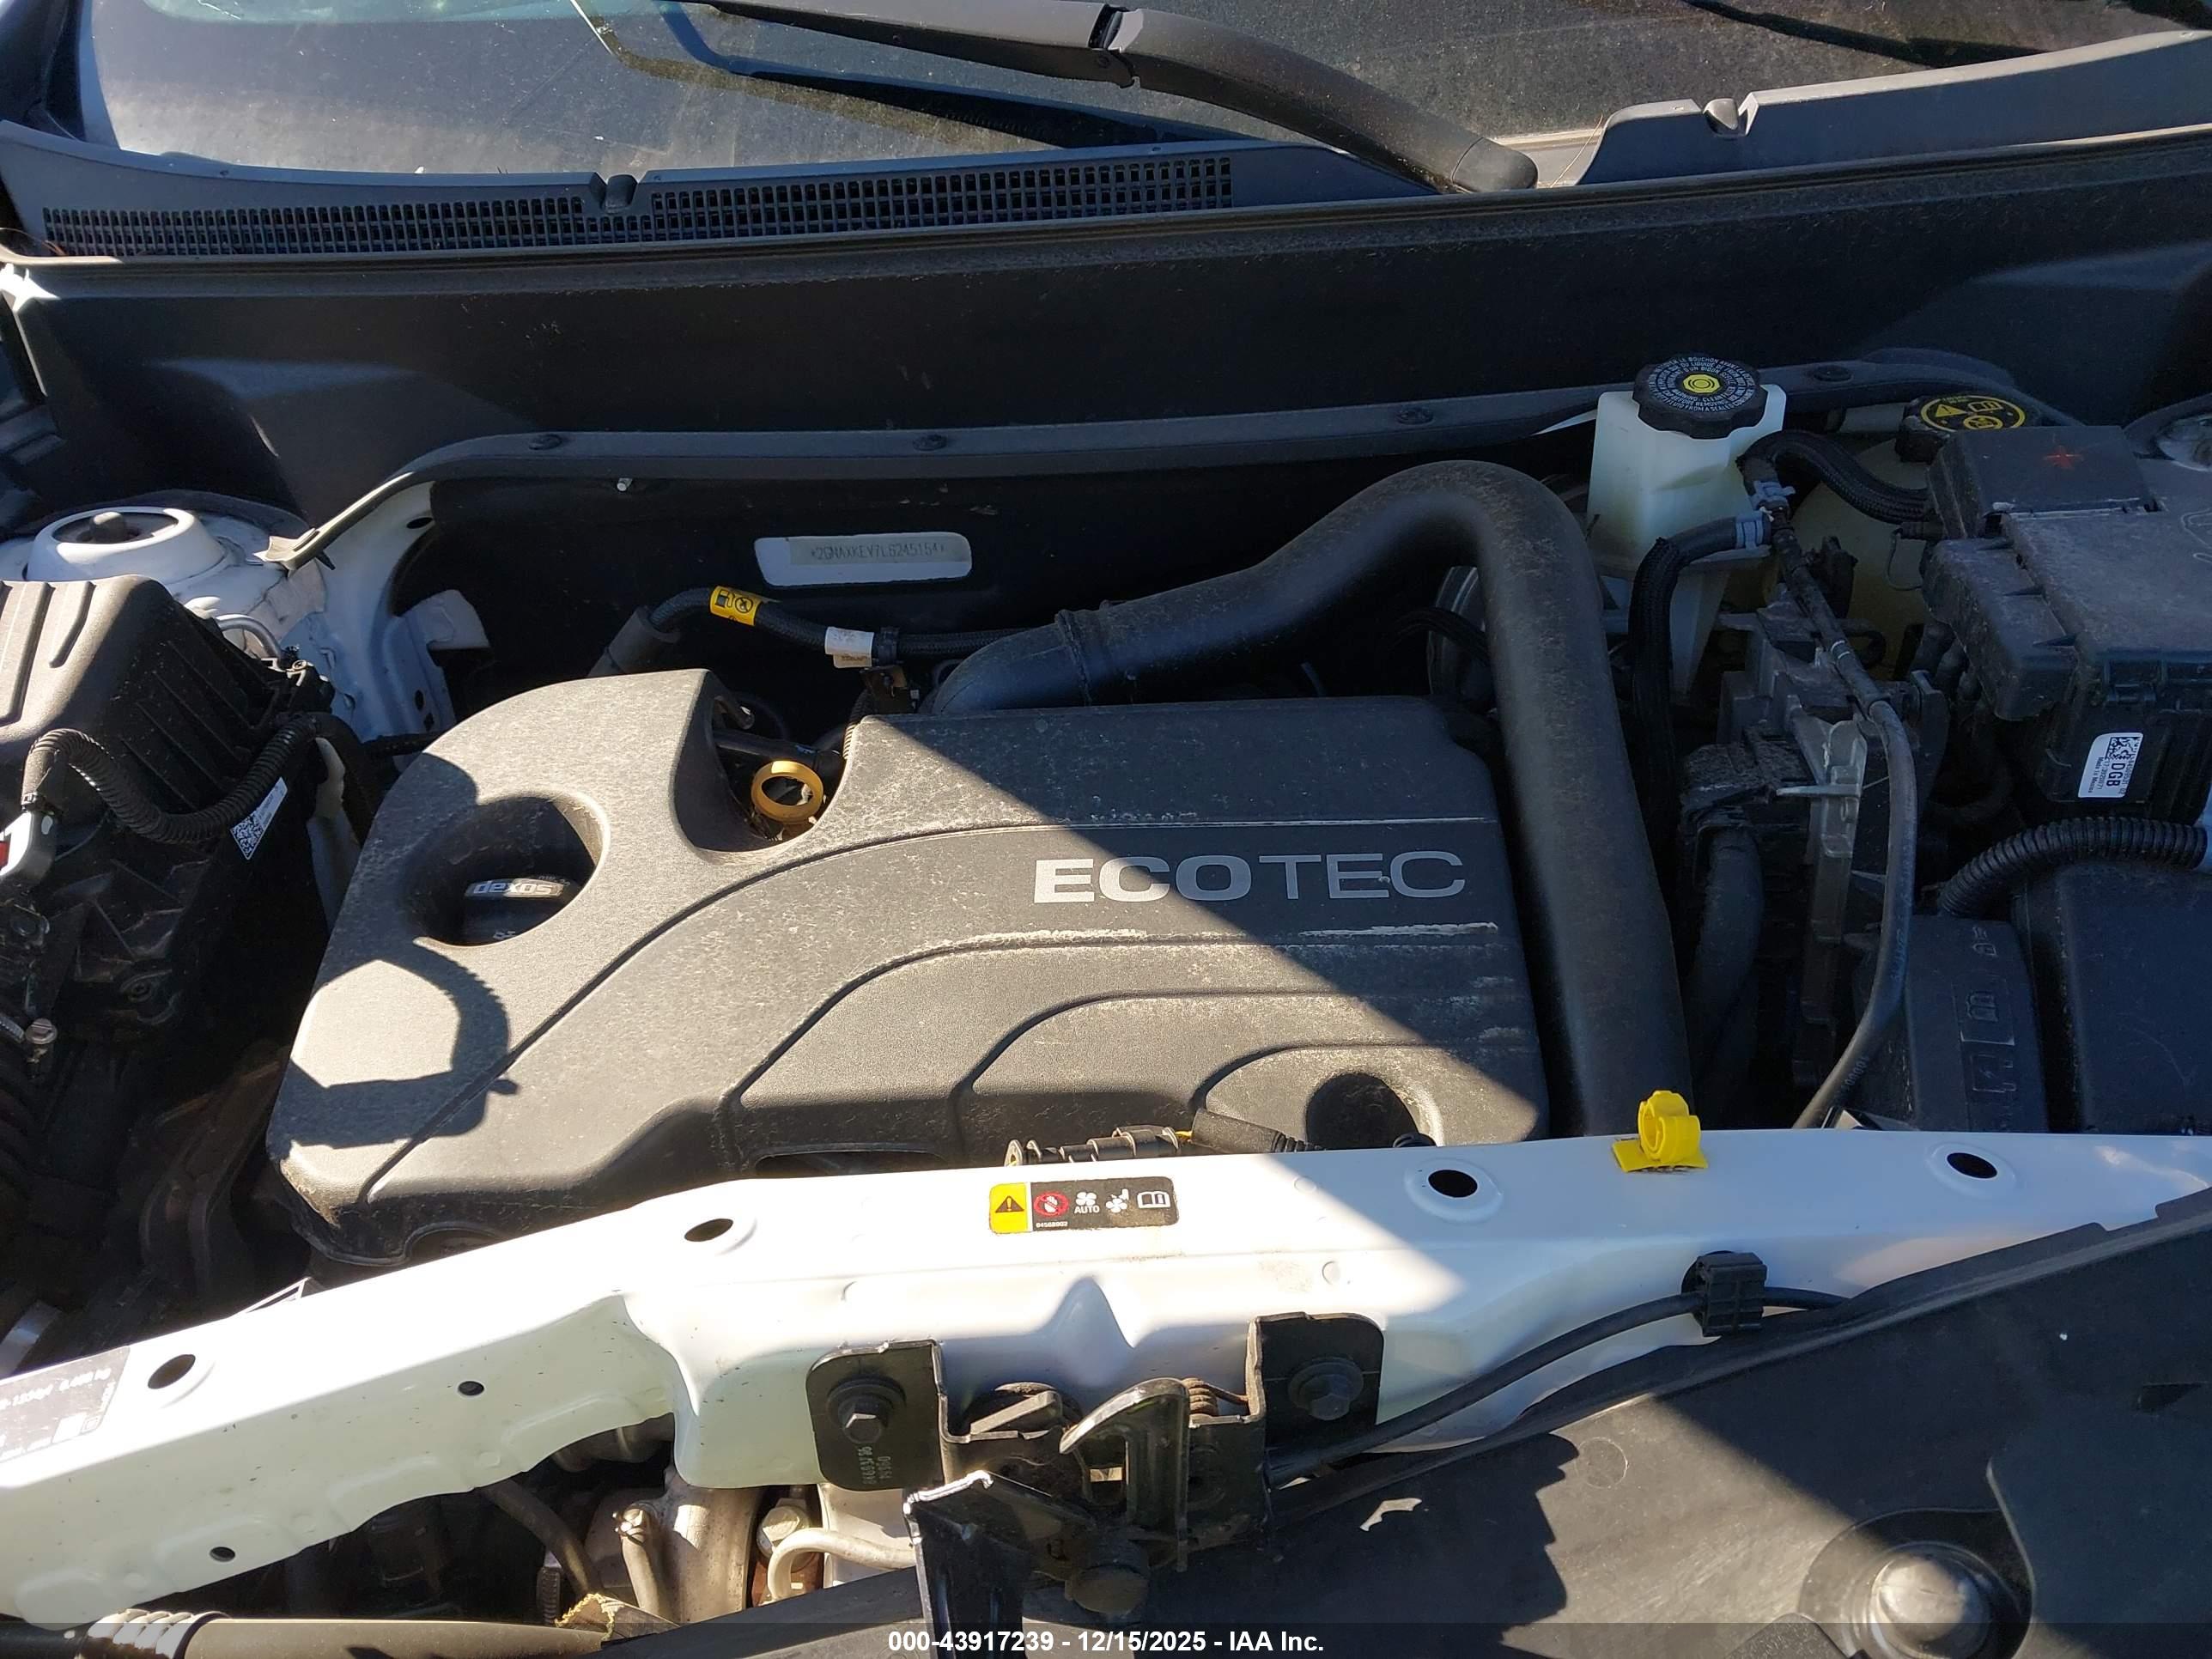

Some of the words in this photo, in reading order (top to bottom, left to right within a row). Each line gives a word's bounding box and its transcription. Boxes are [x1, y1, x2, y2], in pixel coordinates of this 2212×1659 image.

[2106, 763, 2126, 786] DGB
[1034, 851, 1465, 903] ECOTEC
[473, 881, 552, 894] dexos
[1074, 1205, 1100, 1214] AUTO
